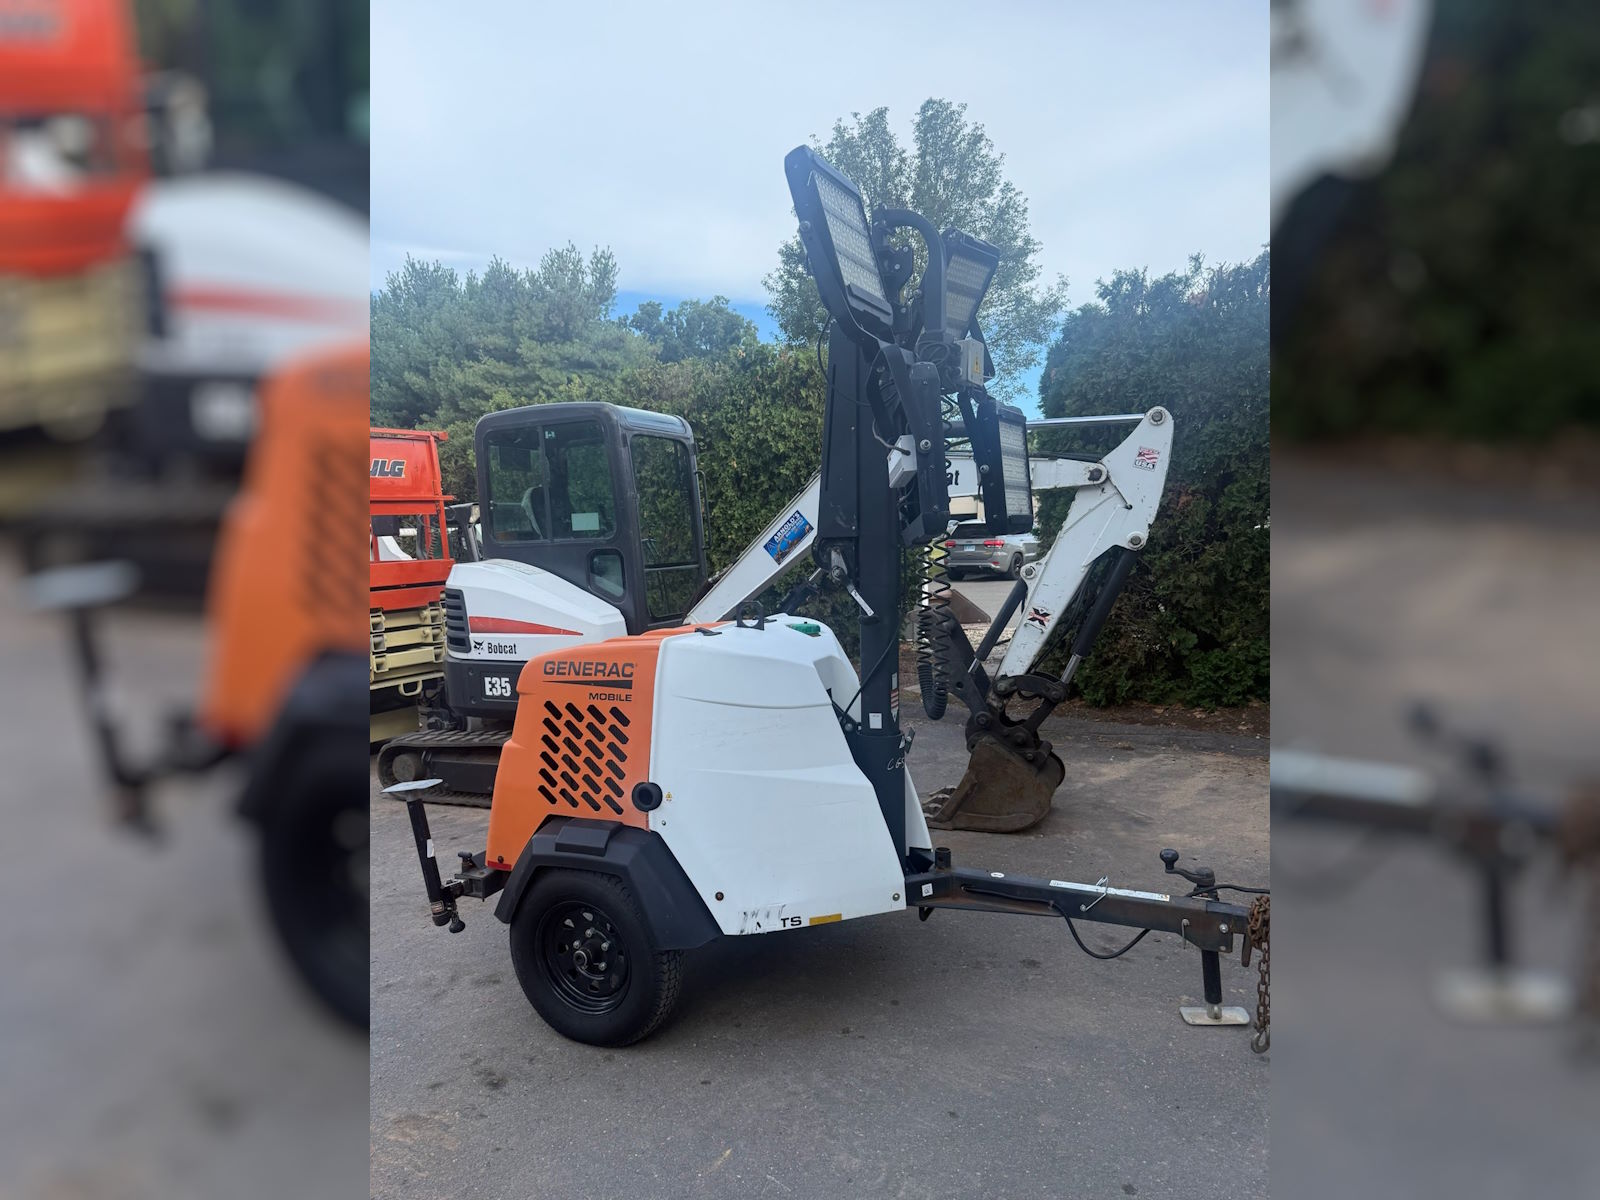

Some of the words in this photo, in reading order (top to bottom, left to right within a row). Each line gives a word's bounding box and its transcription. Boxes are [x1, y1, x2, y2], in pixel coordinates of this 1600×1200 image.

[370, 458, 406, 478] JLG
[773, 511, 801, 543] ARNOLD'S
[487, 642, 517, 654] Bobcat
[543, 660, 635, 678] GENERAC
[484, 676, 512, 697] E35
[588, 692, 633, 702] MOBILE
